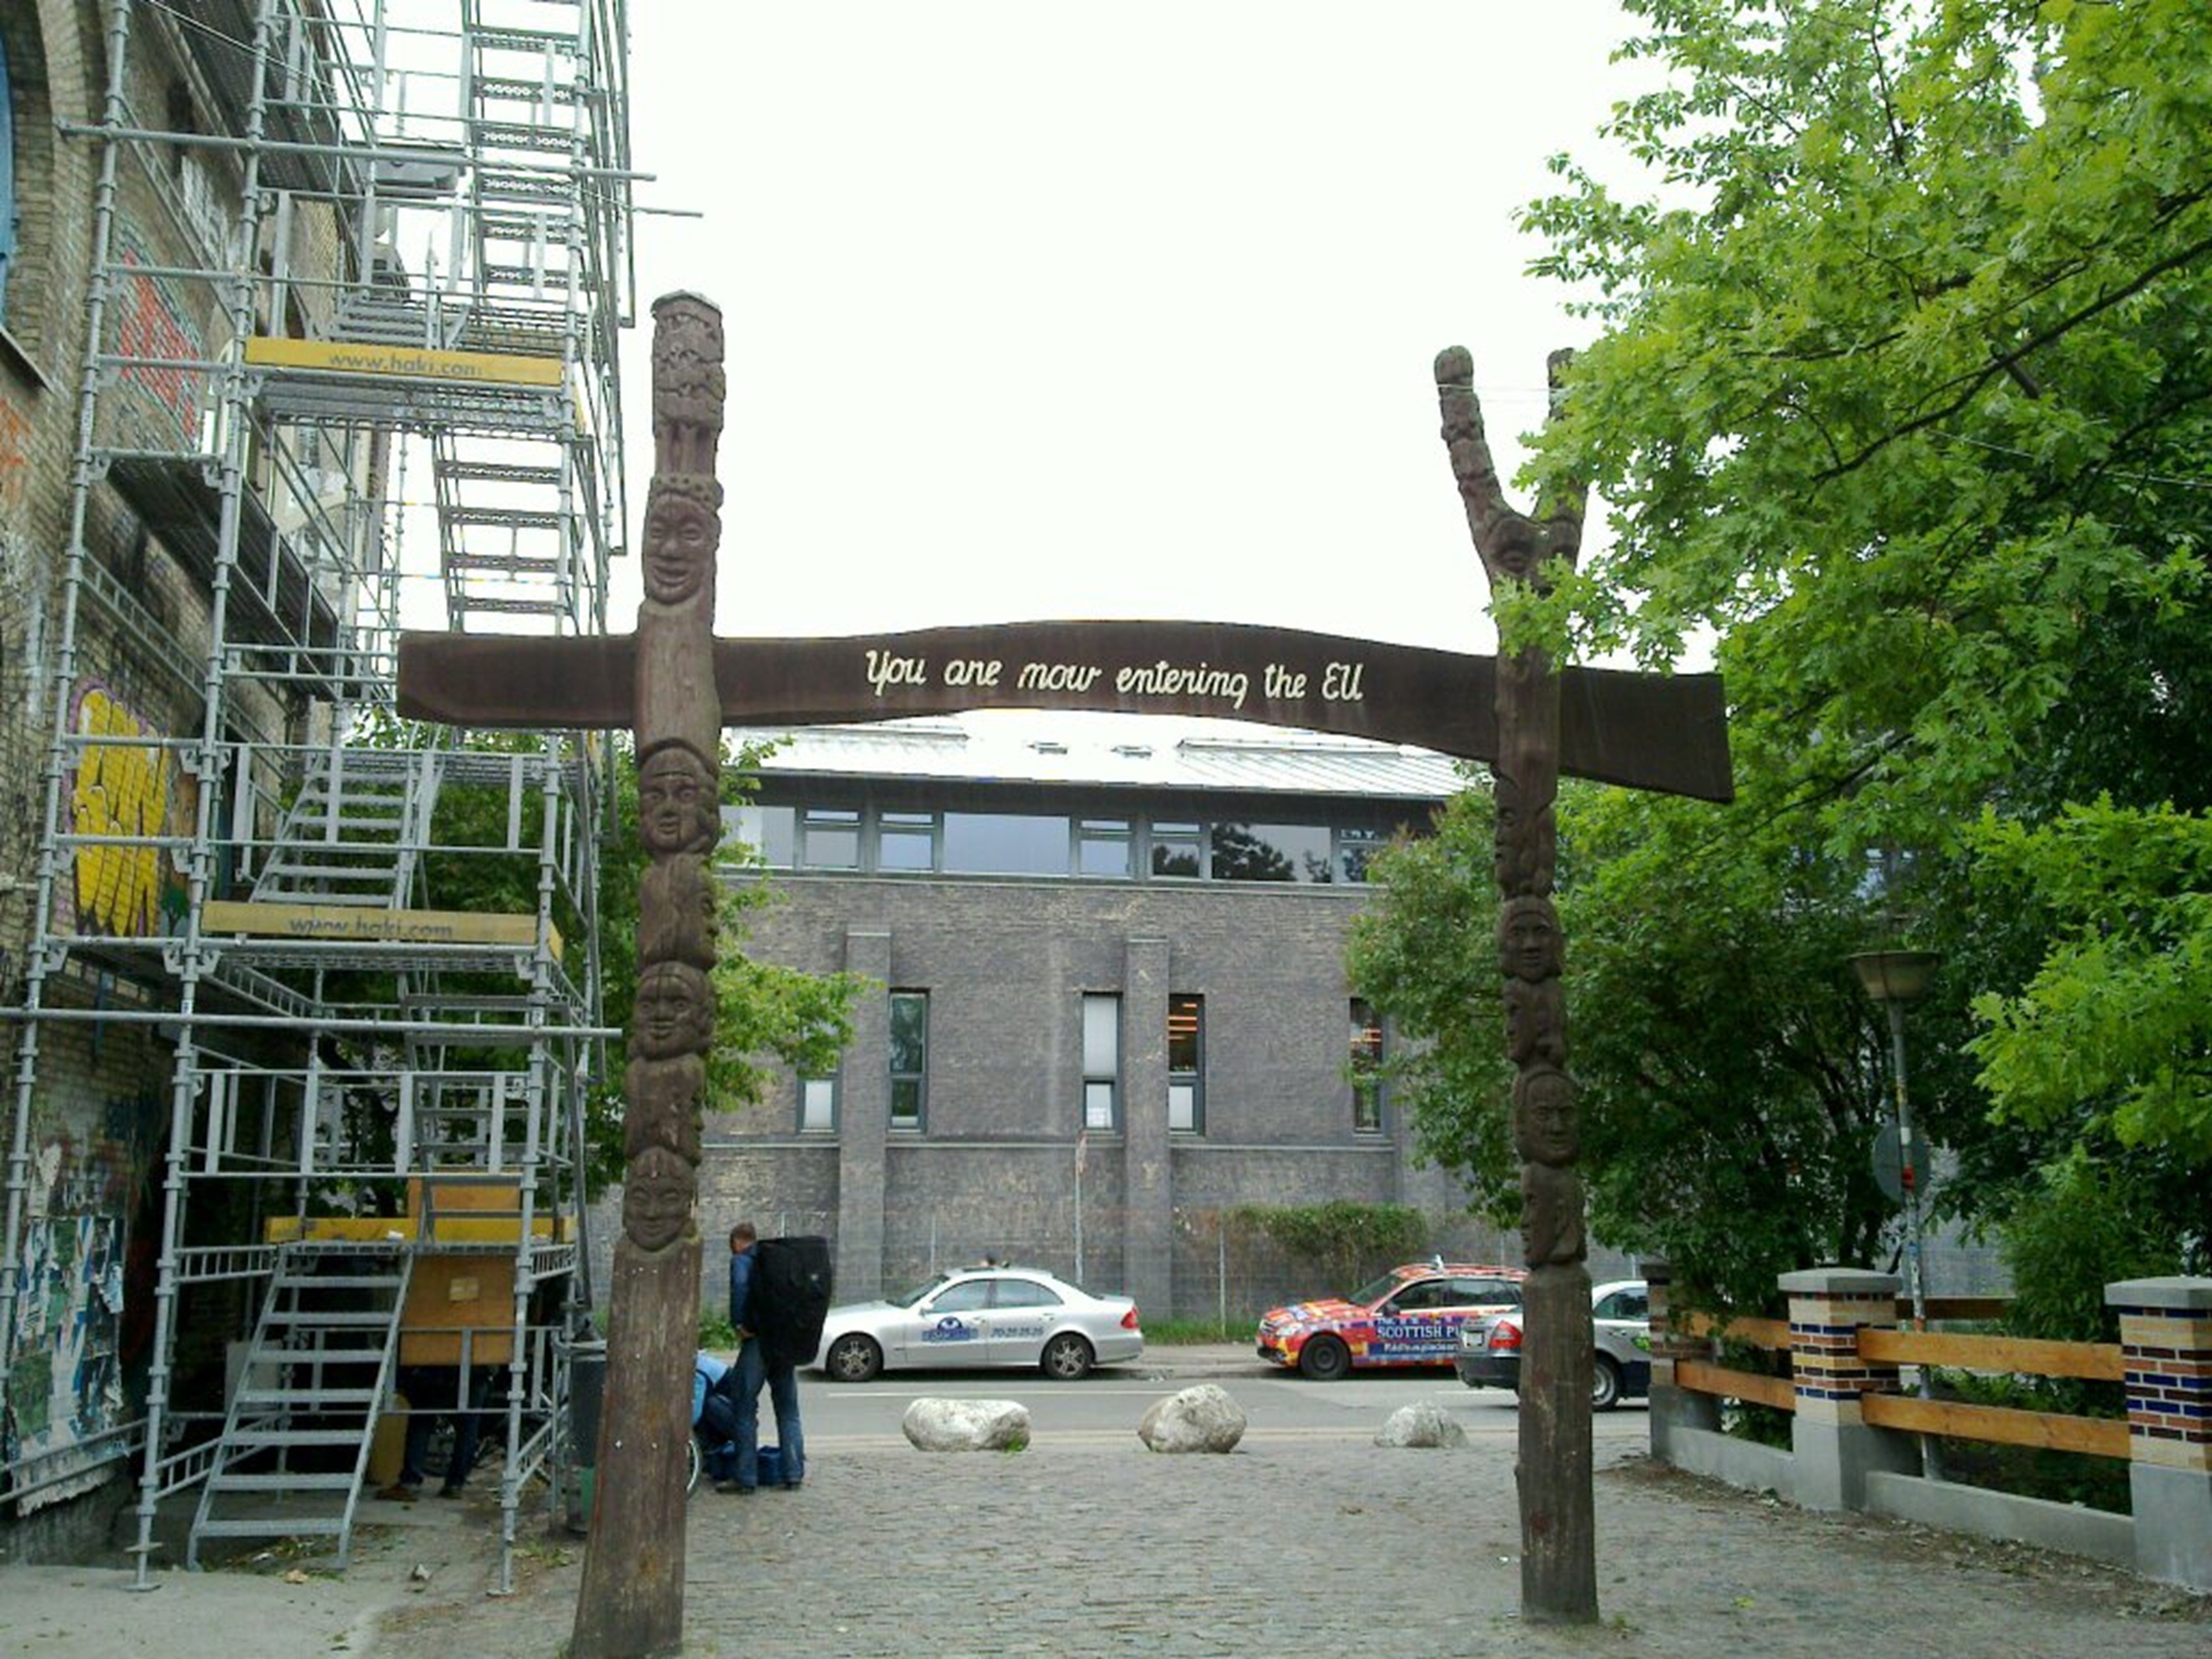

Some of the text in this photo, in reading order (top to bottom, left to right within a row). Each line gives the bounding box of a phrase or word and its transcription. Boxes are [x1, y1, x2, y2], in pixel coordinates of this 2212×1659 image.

[865, 649, 1364, 710] You are now entering the EU
[1377, 1326, 1442, 1338] SCOTTISH
